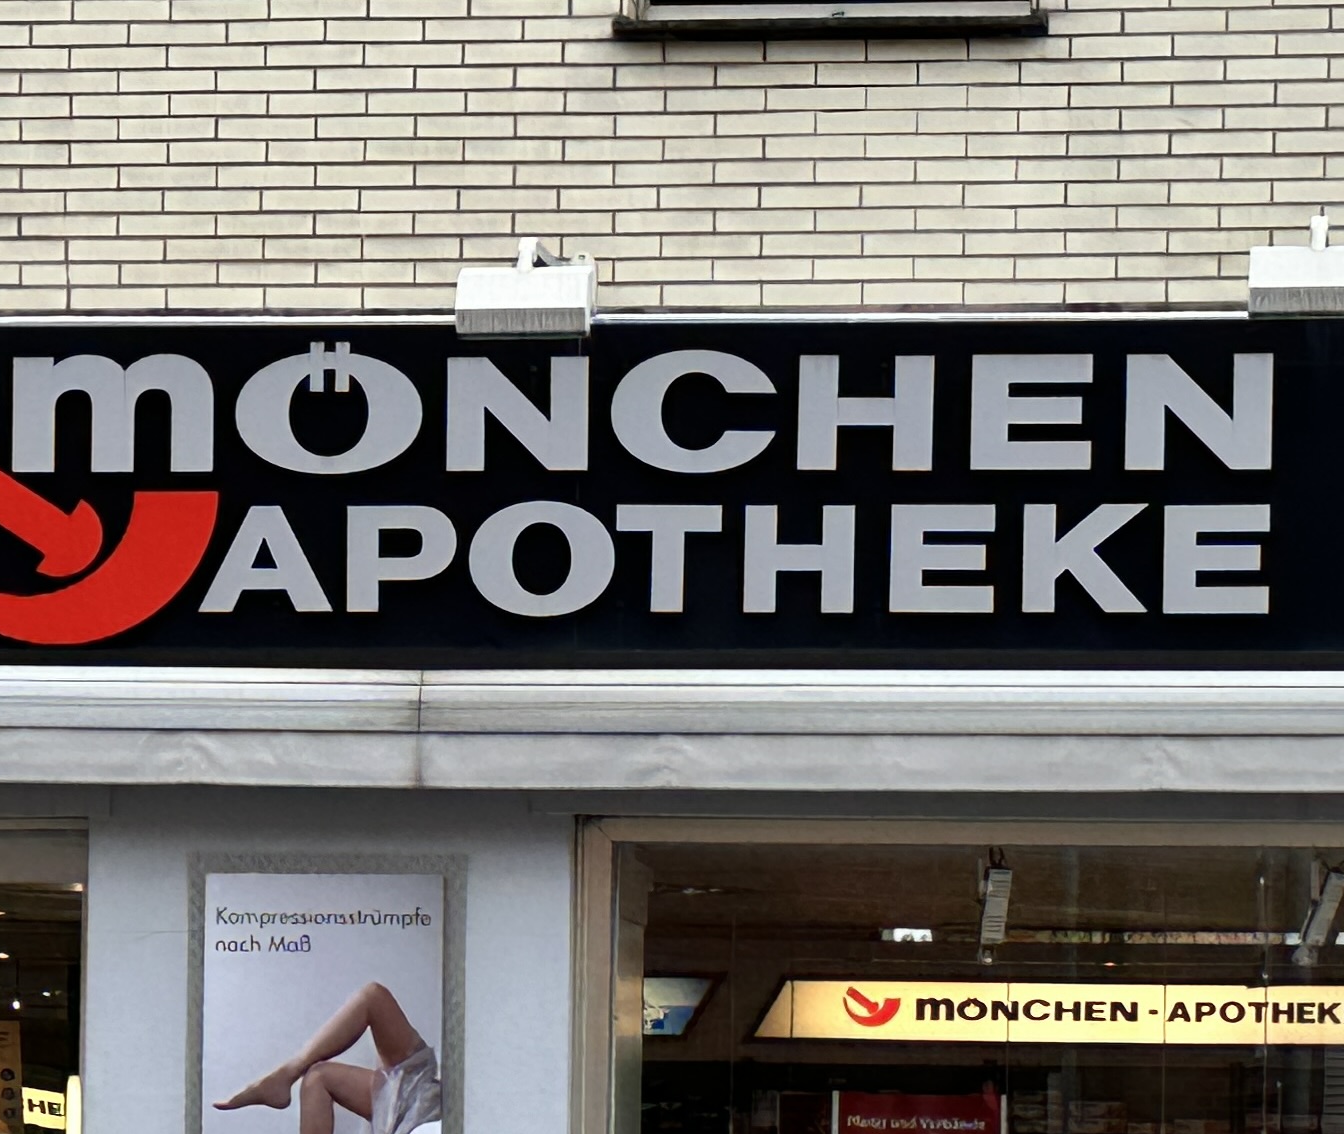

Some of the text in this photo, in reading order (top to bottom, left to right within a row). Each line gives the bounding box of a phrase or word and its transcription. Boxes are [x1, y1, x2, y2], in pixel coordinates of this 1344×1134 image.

[197, 500, 1273, 616] APOTHEKE
[215, 906, 432, 929] Kompressionsstrümpfe
[215, 934, 312, 953] nach Maß
